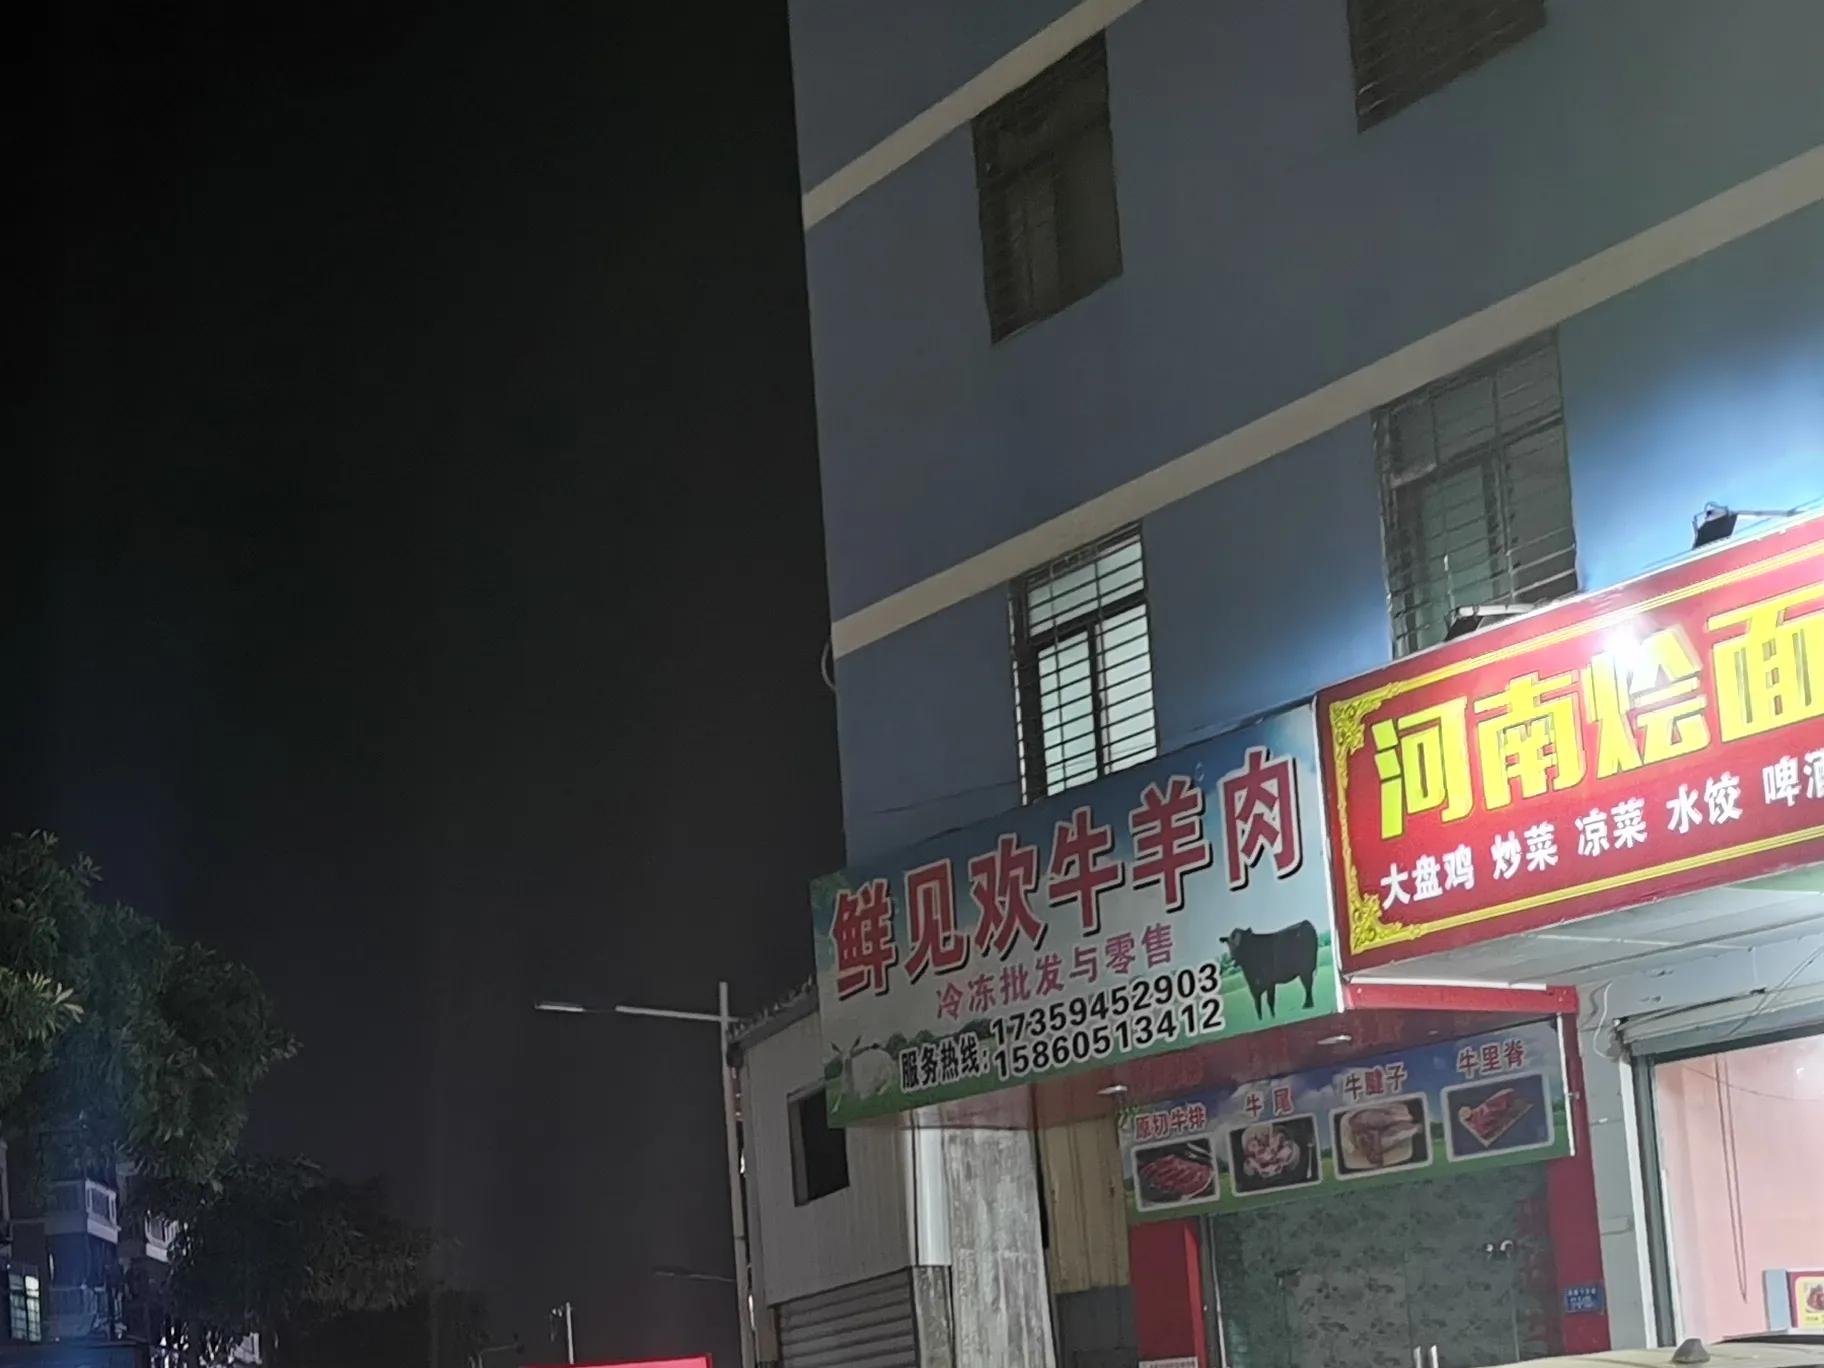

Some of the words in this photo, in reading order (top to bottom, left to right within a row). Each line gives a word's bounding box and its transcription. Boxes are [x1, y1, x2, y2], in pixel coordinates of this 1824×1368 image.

[1372, 583, 1824, 840] 河南烩面
[830, 746, 1304, 1002] 鲜见欢牛羊肉
[1380, 843, 1475, 911] 大盘鸡
[1490, 819, 1559, 882] 炒菜
[1575, 797, 1648, 858] 凉菜
[1666, 770, 1744, 835] 水饺
[936, 923, 1175, 1021] 冷冻批发与零售
[991, 962, 1221, 1046] 17359452903
[992, 997, 1225, 1080] 15860513412
